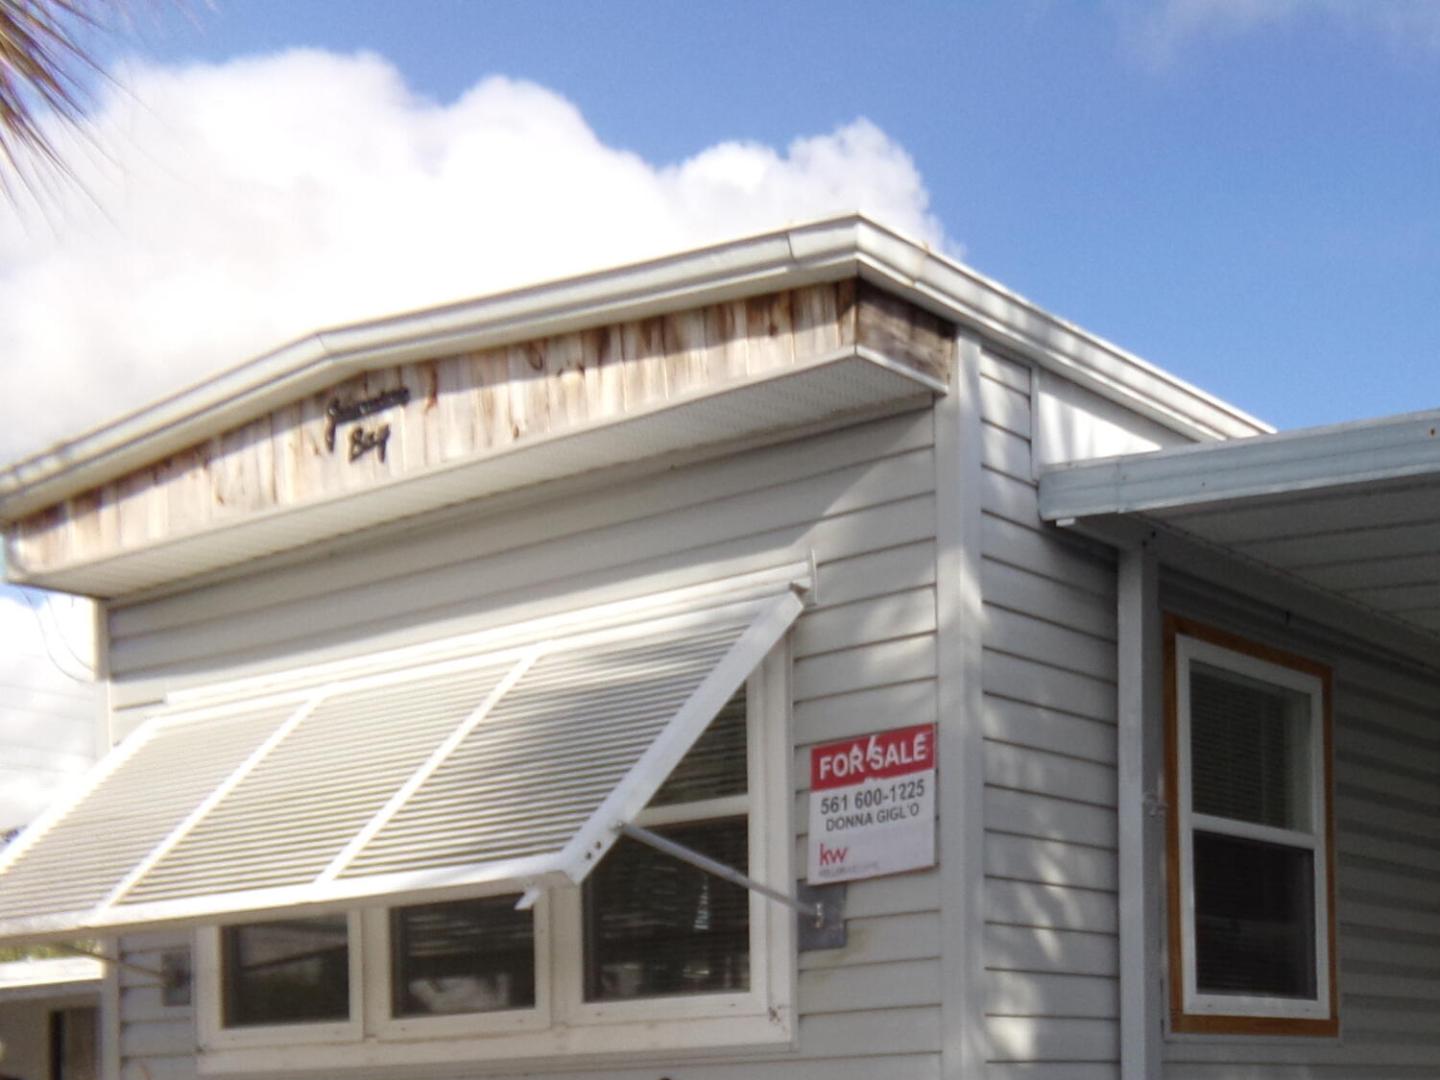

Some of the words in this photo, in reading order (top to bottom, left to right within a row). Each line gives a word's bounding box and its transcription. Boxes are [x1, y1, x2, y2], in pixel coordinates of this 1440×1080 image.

[819, 746, 865, 780] FOR
[869, 733, 927, 770] SALE
[821, 794, 848, 815] 561
[854, 779, 925, 809] 600-1225
[826, 812, 873, 832] DONNA
[876, 802, 920, 824] GIGLO
[819, 843, 848, 866] kw
